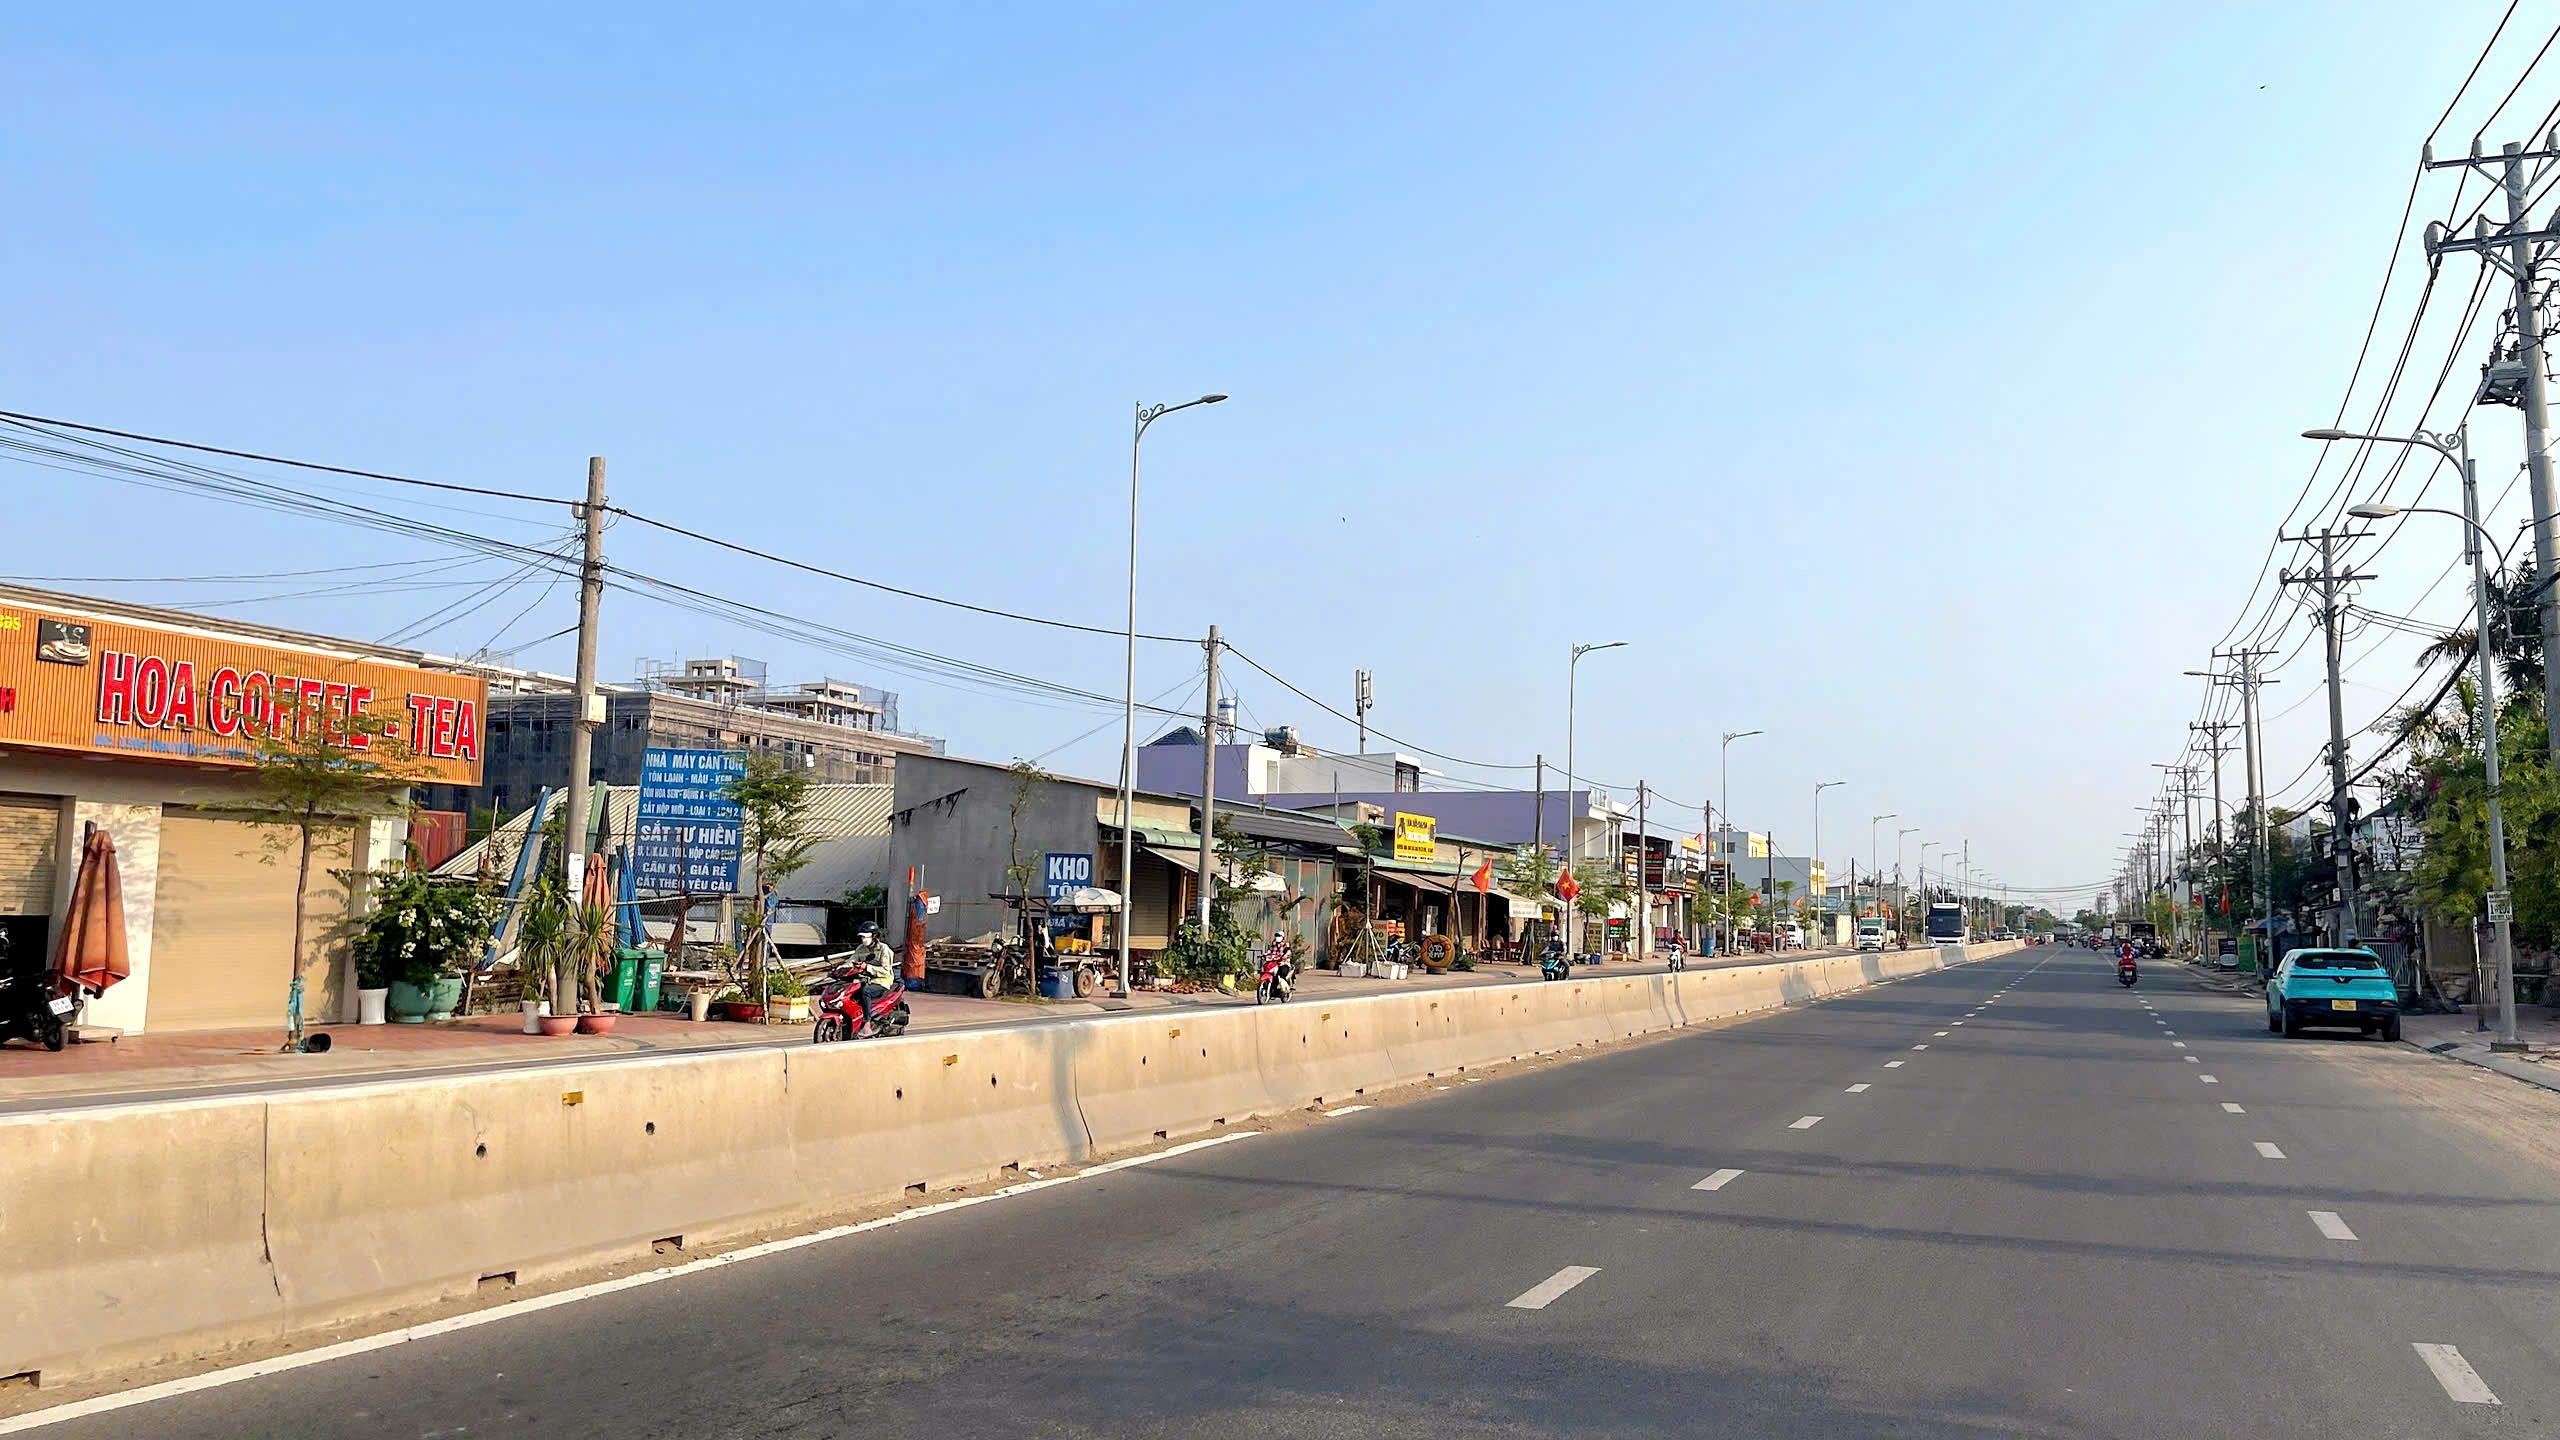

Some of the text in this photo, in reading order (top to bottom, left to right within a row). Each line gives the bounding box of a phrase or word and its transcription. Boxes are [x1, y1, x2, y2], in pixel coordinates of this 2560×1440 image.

[98, 650, 198, 730] HOA
[210, 666, 374, 749] COFFEE
[409, 693, 477, 760] TEA
[646, 752, 667, 768] NHÀ
[672, 752, 696, 769] MÁY
[698, 752, 721, 770] CÁN
[640, 820, 671, 842] SẮT
[698, 823, 737, 846] HIỀN
[690, 862, 710, 876] GIÁ
[1049, 857, 1089, 880] KHO
[688, 879, 709, 891] YÊU
